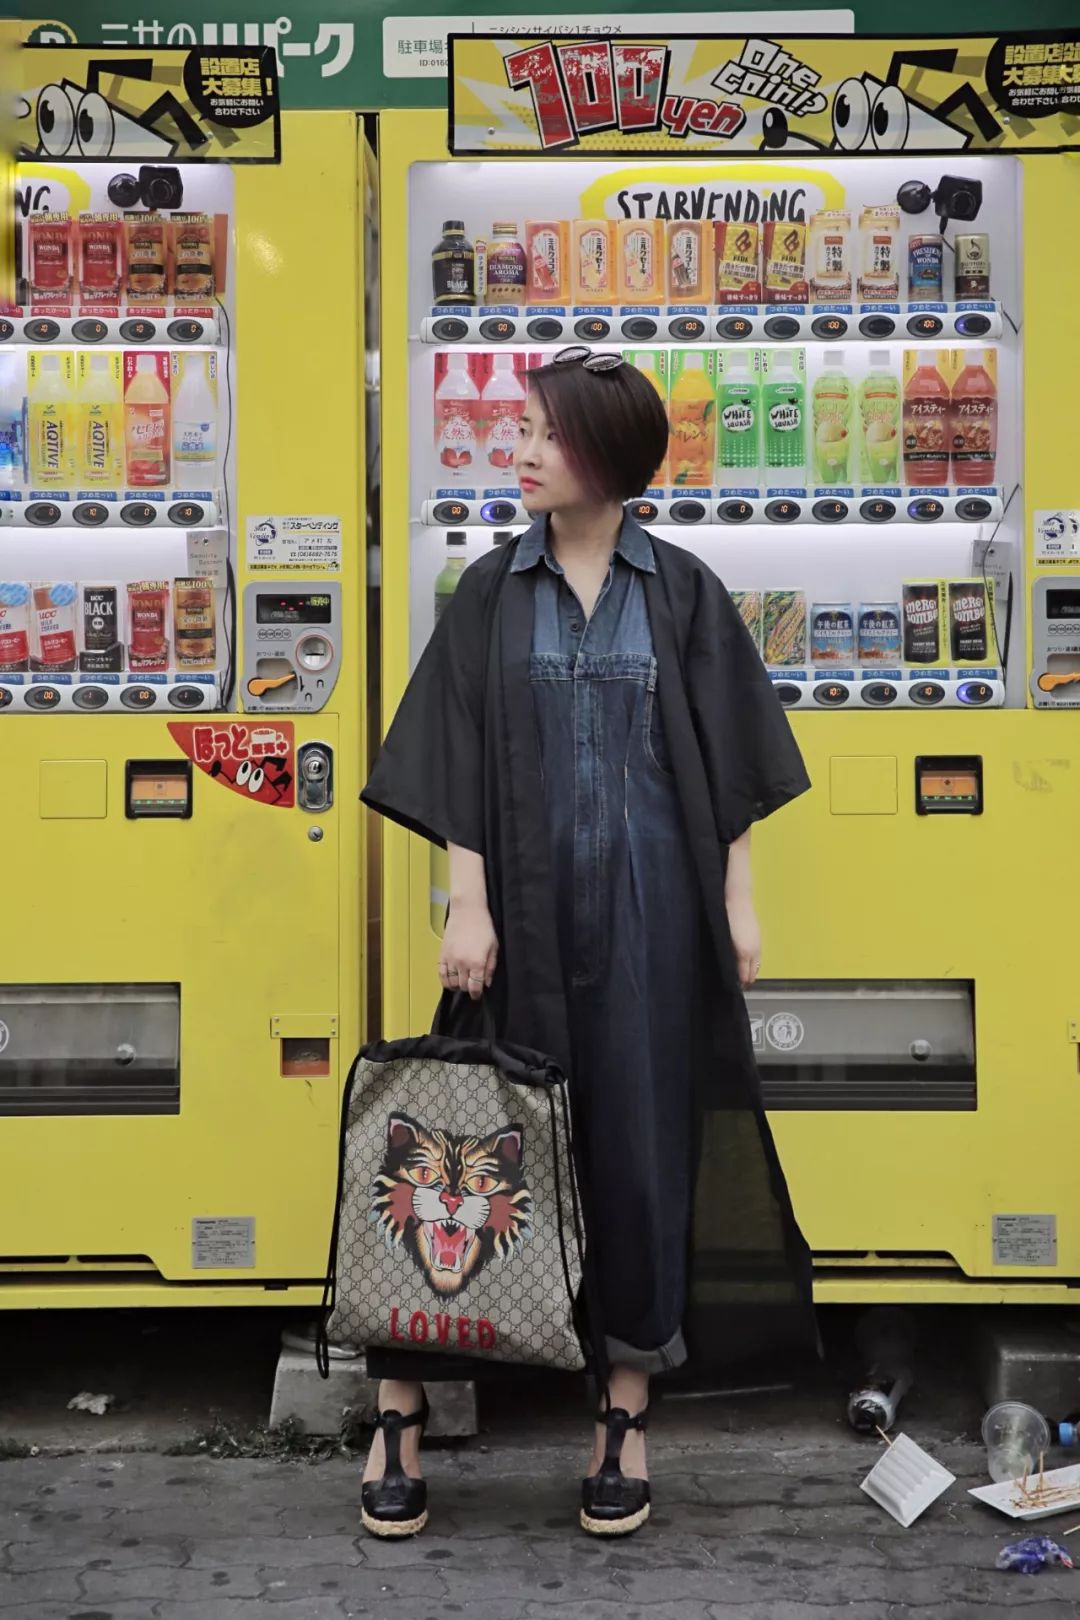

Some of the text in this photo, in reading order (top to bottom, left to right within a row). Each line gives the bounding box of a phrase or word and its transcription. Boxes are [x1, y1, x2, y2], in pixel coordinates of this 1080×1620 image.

[398, 39, 448, 55] 駐車場
[200, 57, 260, 76] 設置店
[738, 38, 823, 87] One
[504, 40, 668, 149] 100
[661, 97, 746, 136] yen
[911, 404, 946, 414] アイスティー
[958, 404, 993, 415] アイスティー
[727, 419, 751, 428] SQUASH
[774, 419, 798, 428] SQUASH
[46, 420, 59, 469] AQTIVE
[92, 420, 105, 469] AQTIVE
[39, 610, 57, 620] UCC
[84, 601, 113, 616] BLACK
[136, 612, 158, 621] WONDA
[817, 620, 849, 629] 午後の紅茶
[863, 620, 896, 629] 午後の紅茶
[193, 724, 250, 762] ほっと
[389, 1307, 497, 1350] LOVED
